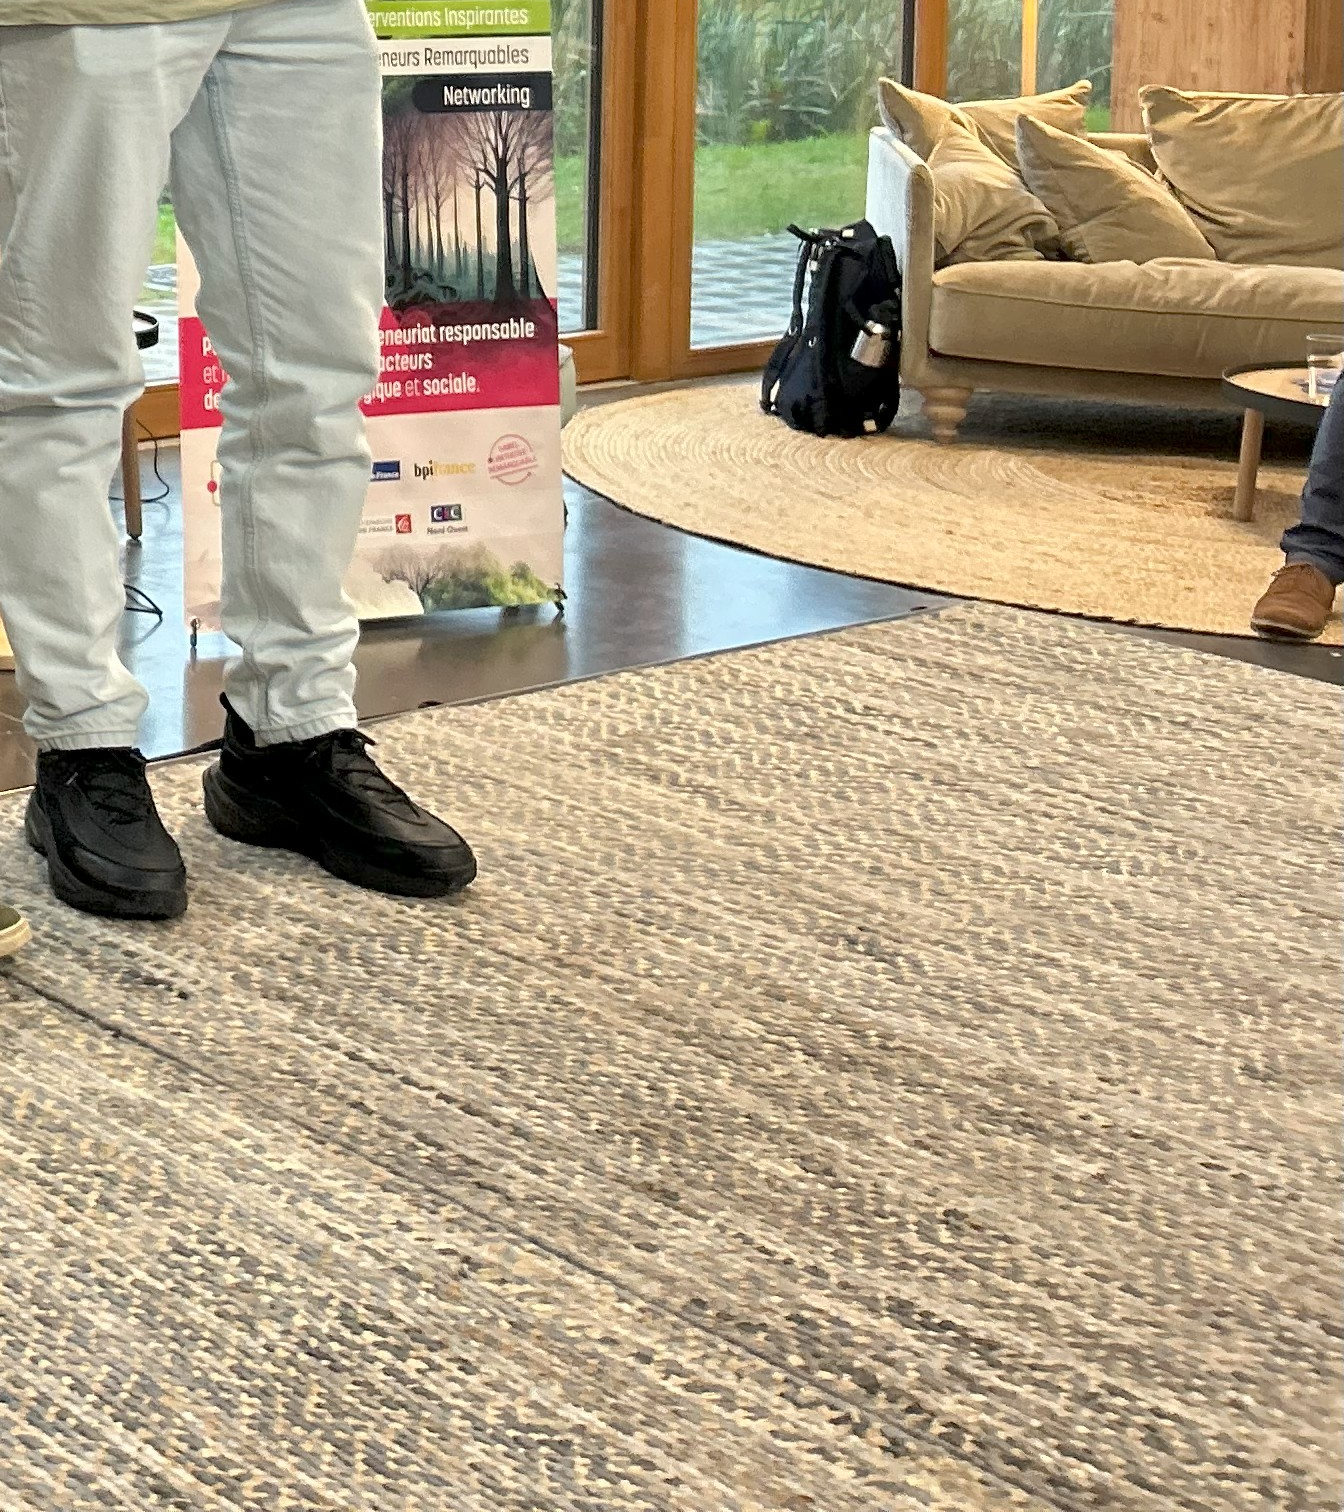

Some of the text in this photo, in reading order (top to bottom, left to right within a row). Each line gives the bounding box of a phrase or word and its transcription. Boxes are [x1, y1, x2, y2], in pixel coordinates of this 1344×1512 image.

[445, 4, 529, 29] Inspirantes
[378, 45, 529, 69] neurs Remarquables
[443, 83, 531, 108] Networking
[439, 317, 535, 345] responsable
[405, 378, 421, 397] et
[423, 372, 480, 397] sociale.
